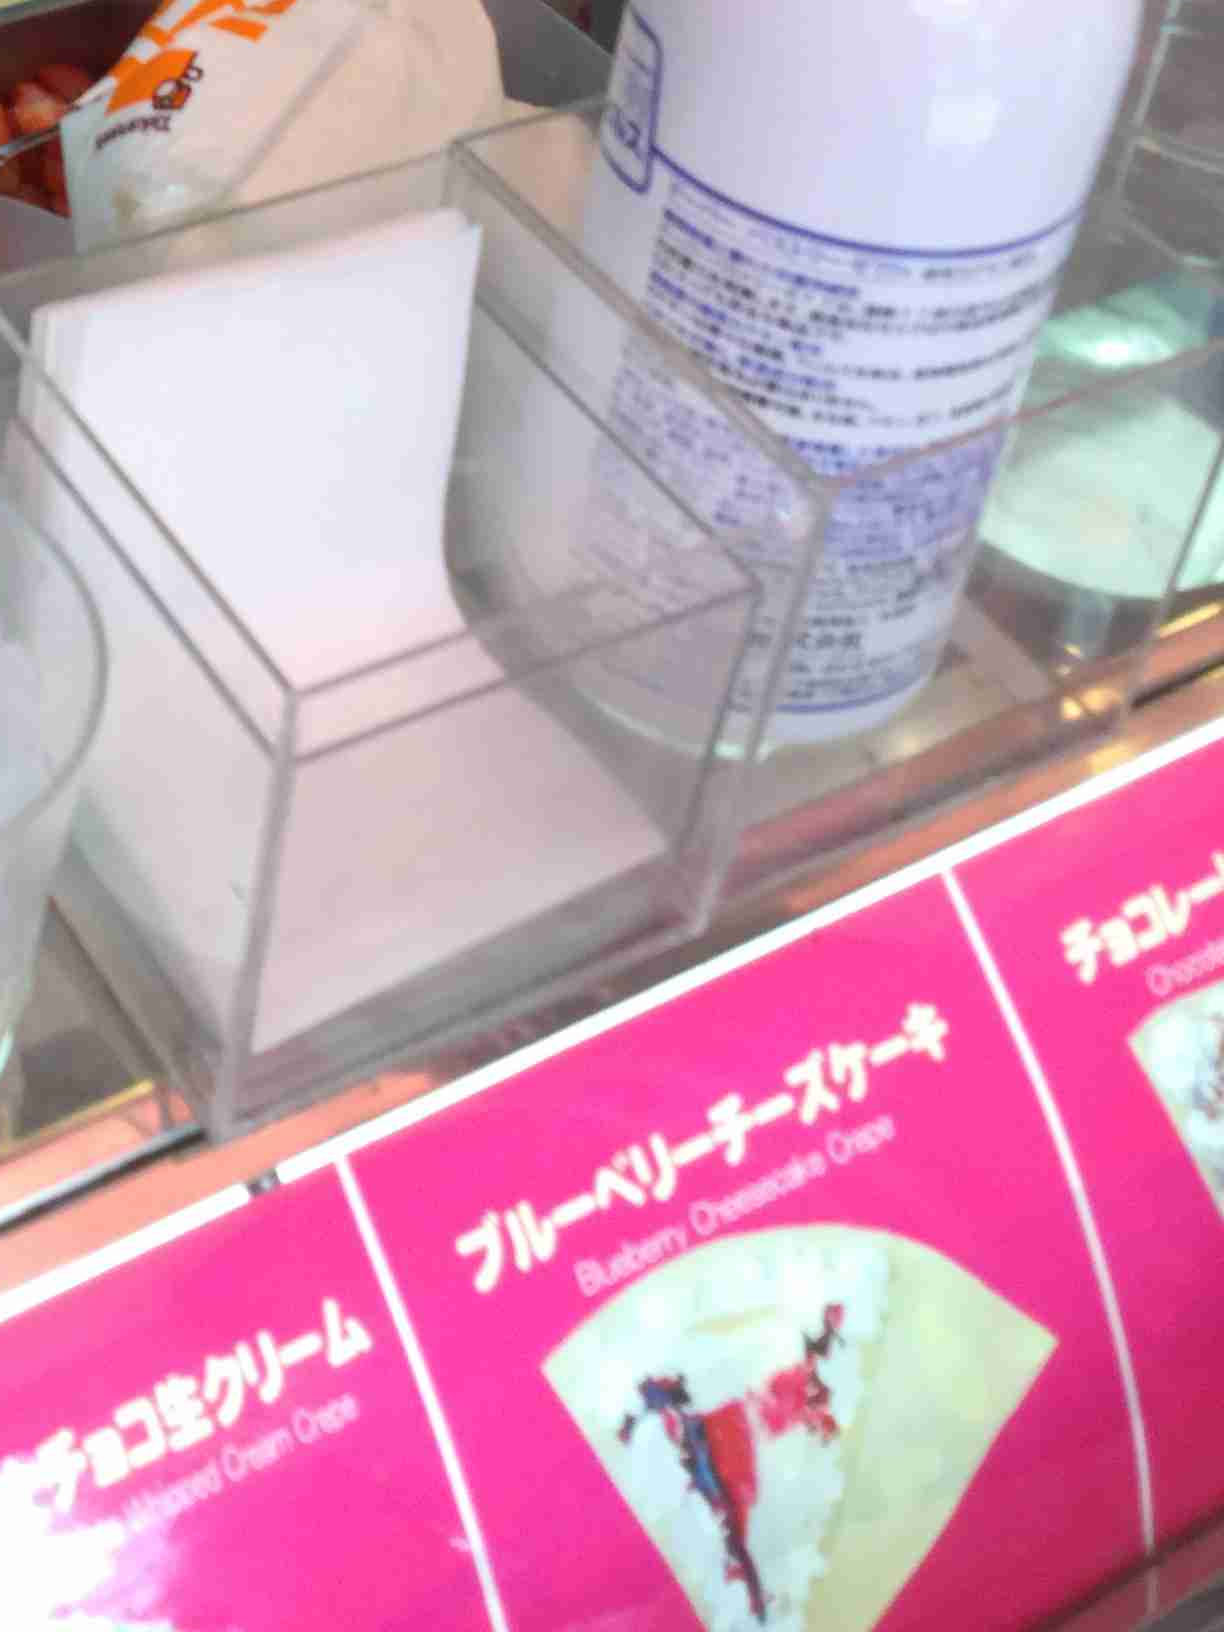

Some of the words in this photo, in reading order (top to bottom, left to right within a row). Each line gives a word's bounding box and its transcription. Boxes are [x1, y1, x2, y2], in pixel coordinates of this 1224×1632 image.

[455, 1003, 949, 1292] ブルーベリーチーズケーキ
